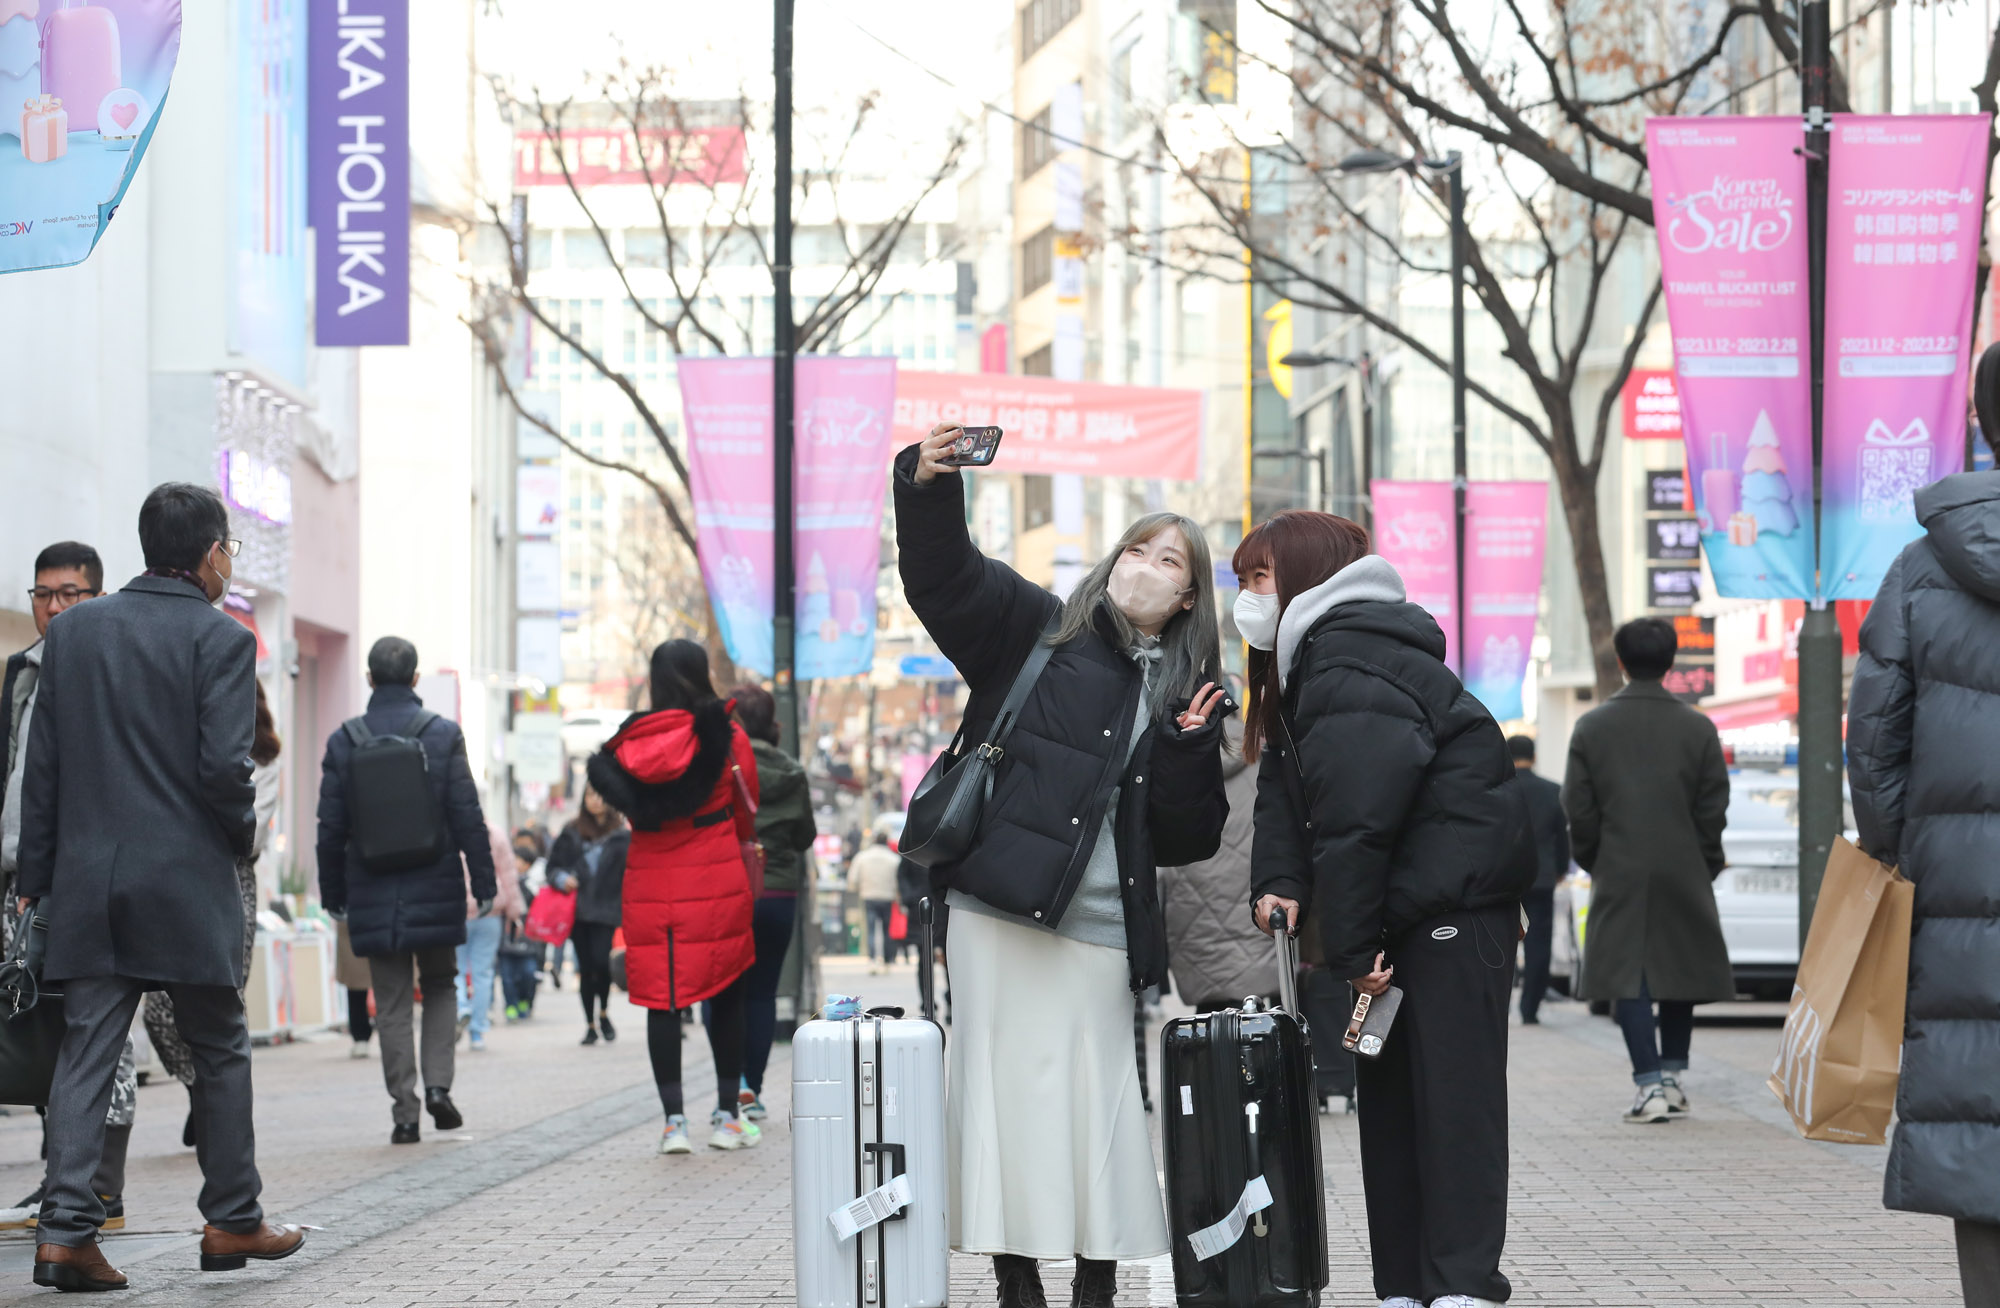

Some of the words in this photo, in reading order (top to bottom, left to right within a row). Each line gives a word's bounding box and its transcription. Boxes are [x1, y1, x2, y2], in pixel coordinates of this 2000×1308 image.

[1713, 175, 1777, 196] Korea
[1842, 187, 1974, 206] コリアグランドセール
[337, 115, 386, 317] HOLIKA
[1668, 193, 1792, 254] Sale
[1668, 281, 1715, 296] TRAVEL
[1717, 281, 1767, 296] BUCKET
[1769, 281, 1797, 296] LIST
[1643, 377, 1675, 395] ALL
